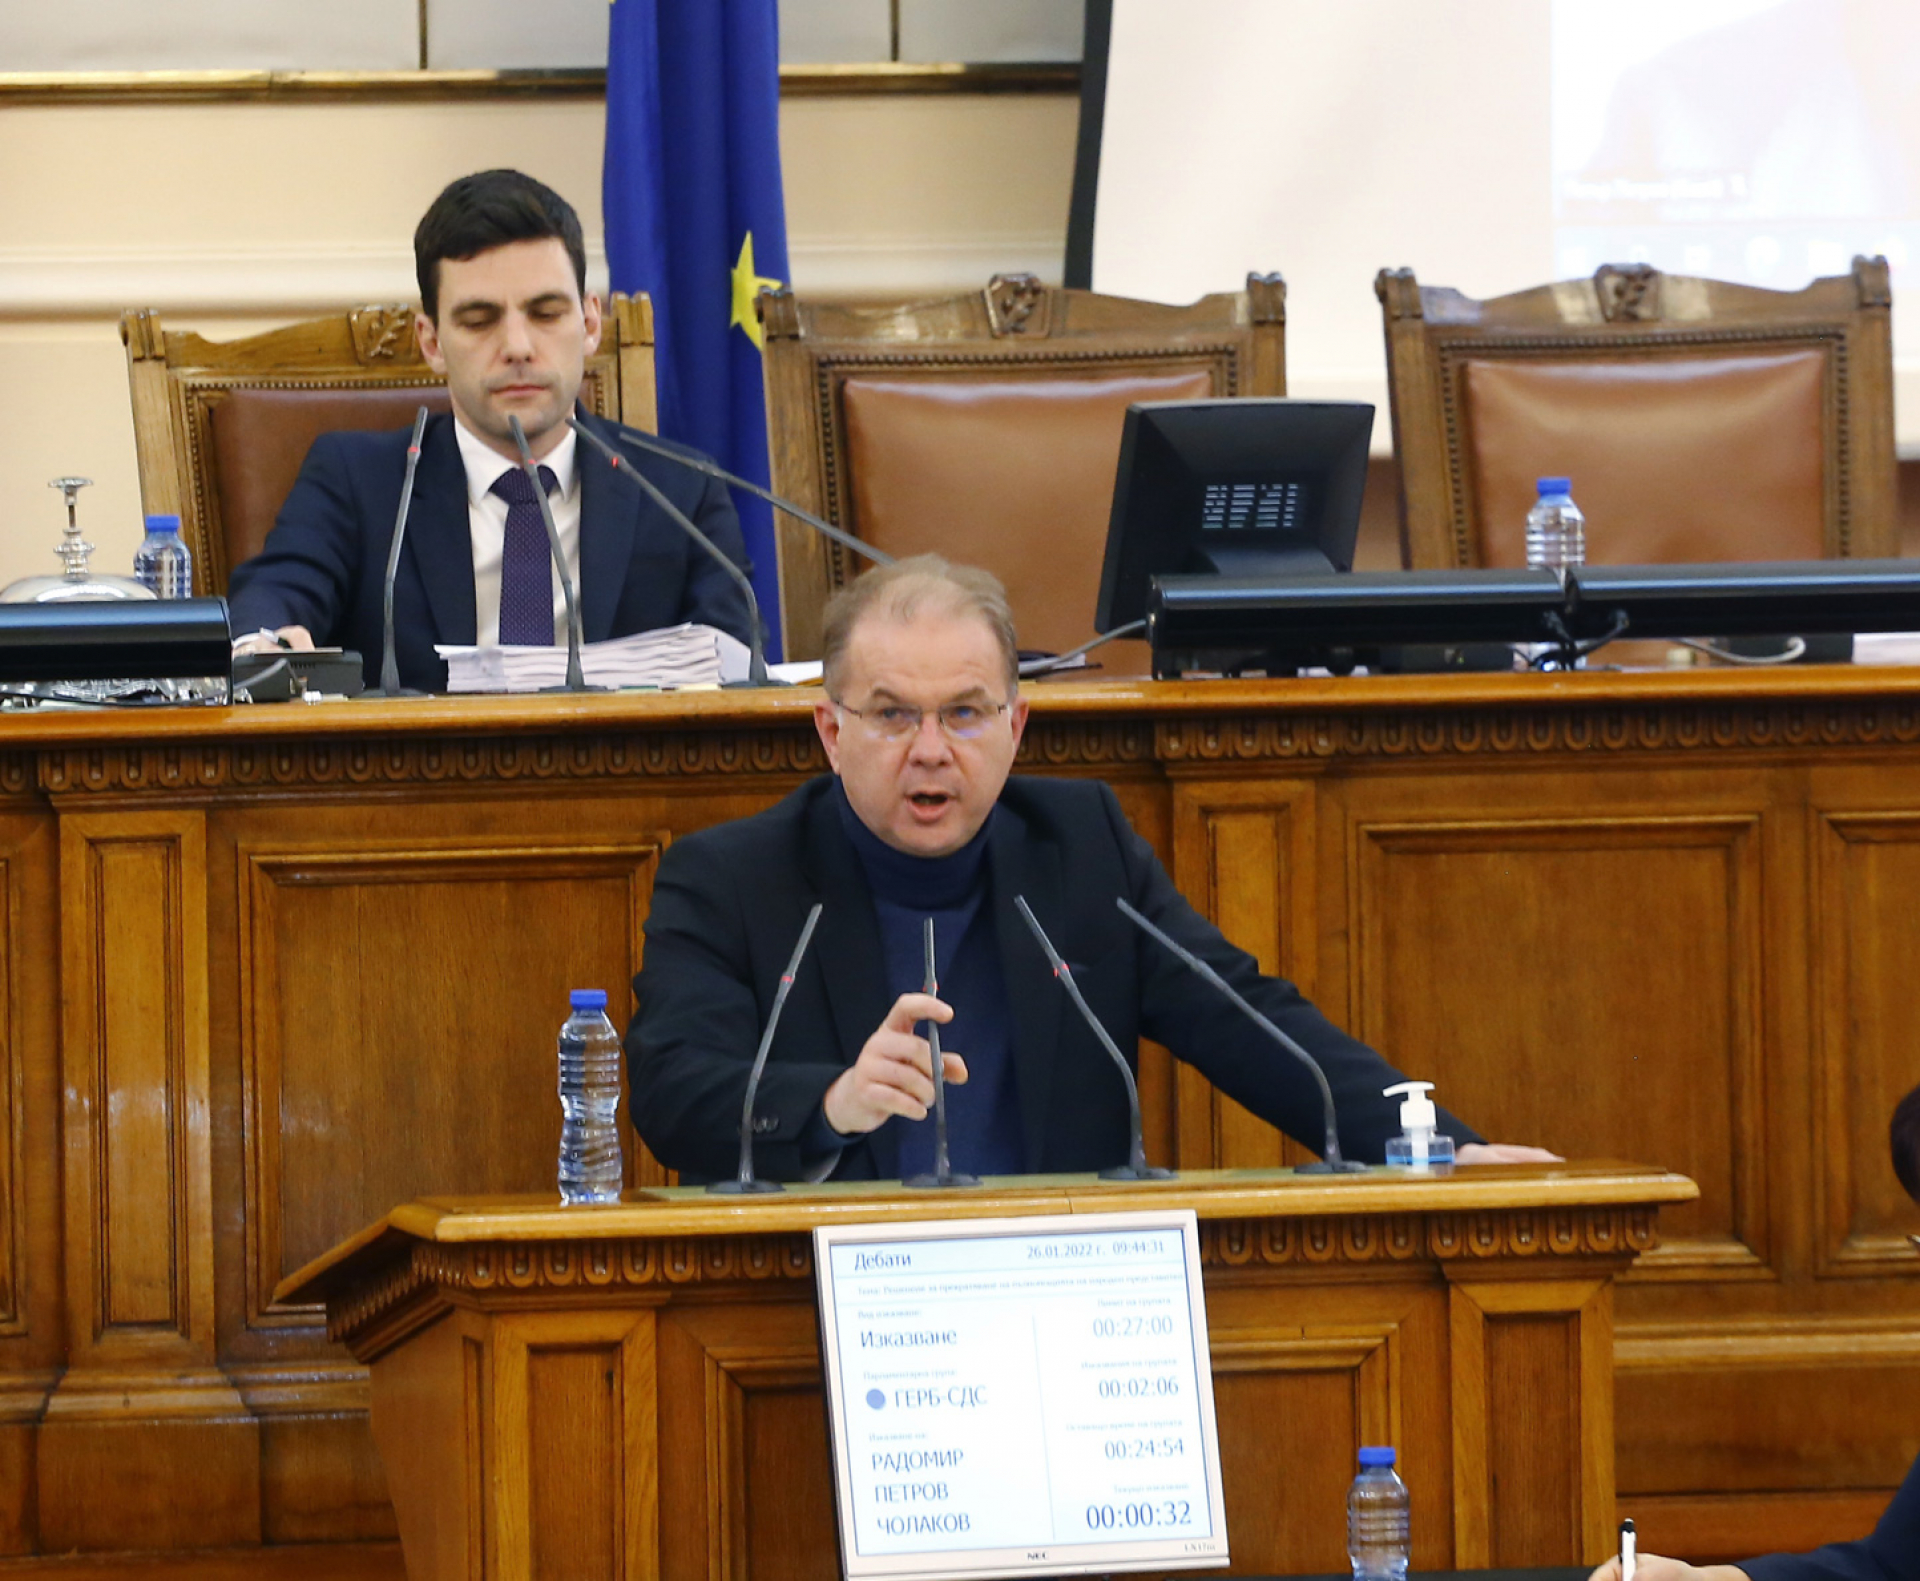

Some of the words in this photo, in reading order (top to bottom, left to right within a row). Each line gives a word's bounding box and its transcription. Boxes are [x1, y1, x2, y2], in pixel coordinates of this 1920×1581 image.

[854, 1250, 912, 1271] Дебати
[1026, 1242, 1092, 1259] 26.01.2022
[1112, 1239, 1165, 1255] 09:44:31
[1092, 1314, 1174, 1338] 00:27:00
[860, 1328, 958, 1349] Изказване
[895, 1384, 988, 1408] ГЕРБ-СДС
[1099, 1375, 1179, 1399] 00:02:06
[872, 1448, 965, 1473] РАДОМИР
[1104, 1437, 1184, 1460] 00:24:54
[874, 1481, 949, 1503] ПЕТРОВ
[876, 1512, 971, 1536] ЧОЛАКОВ
[1086, 1500, 1192, 1530] 00:00:32
